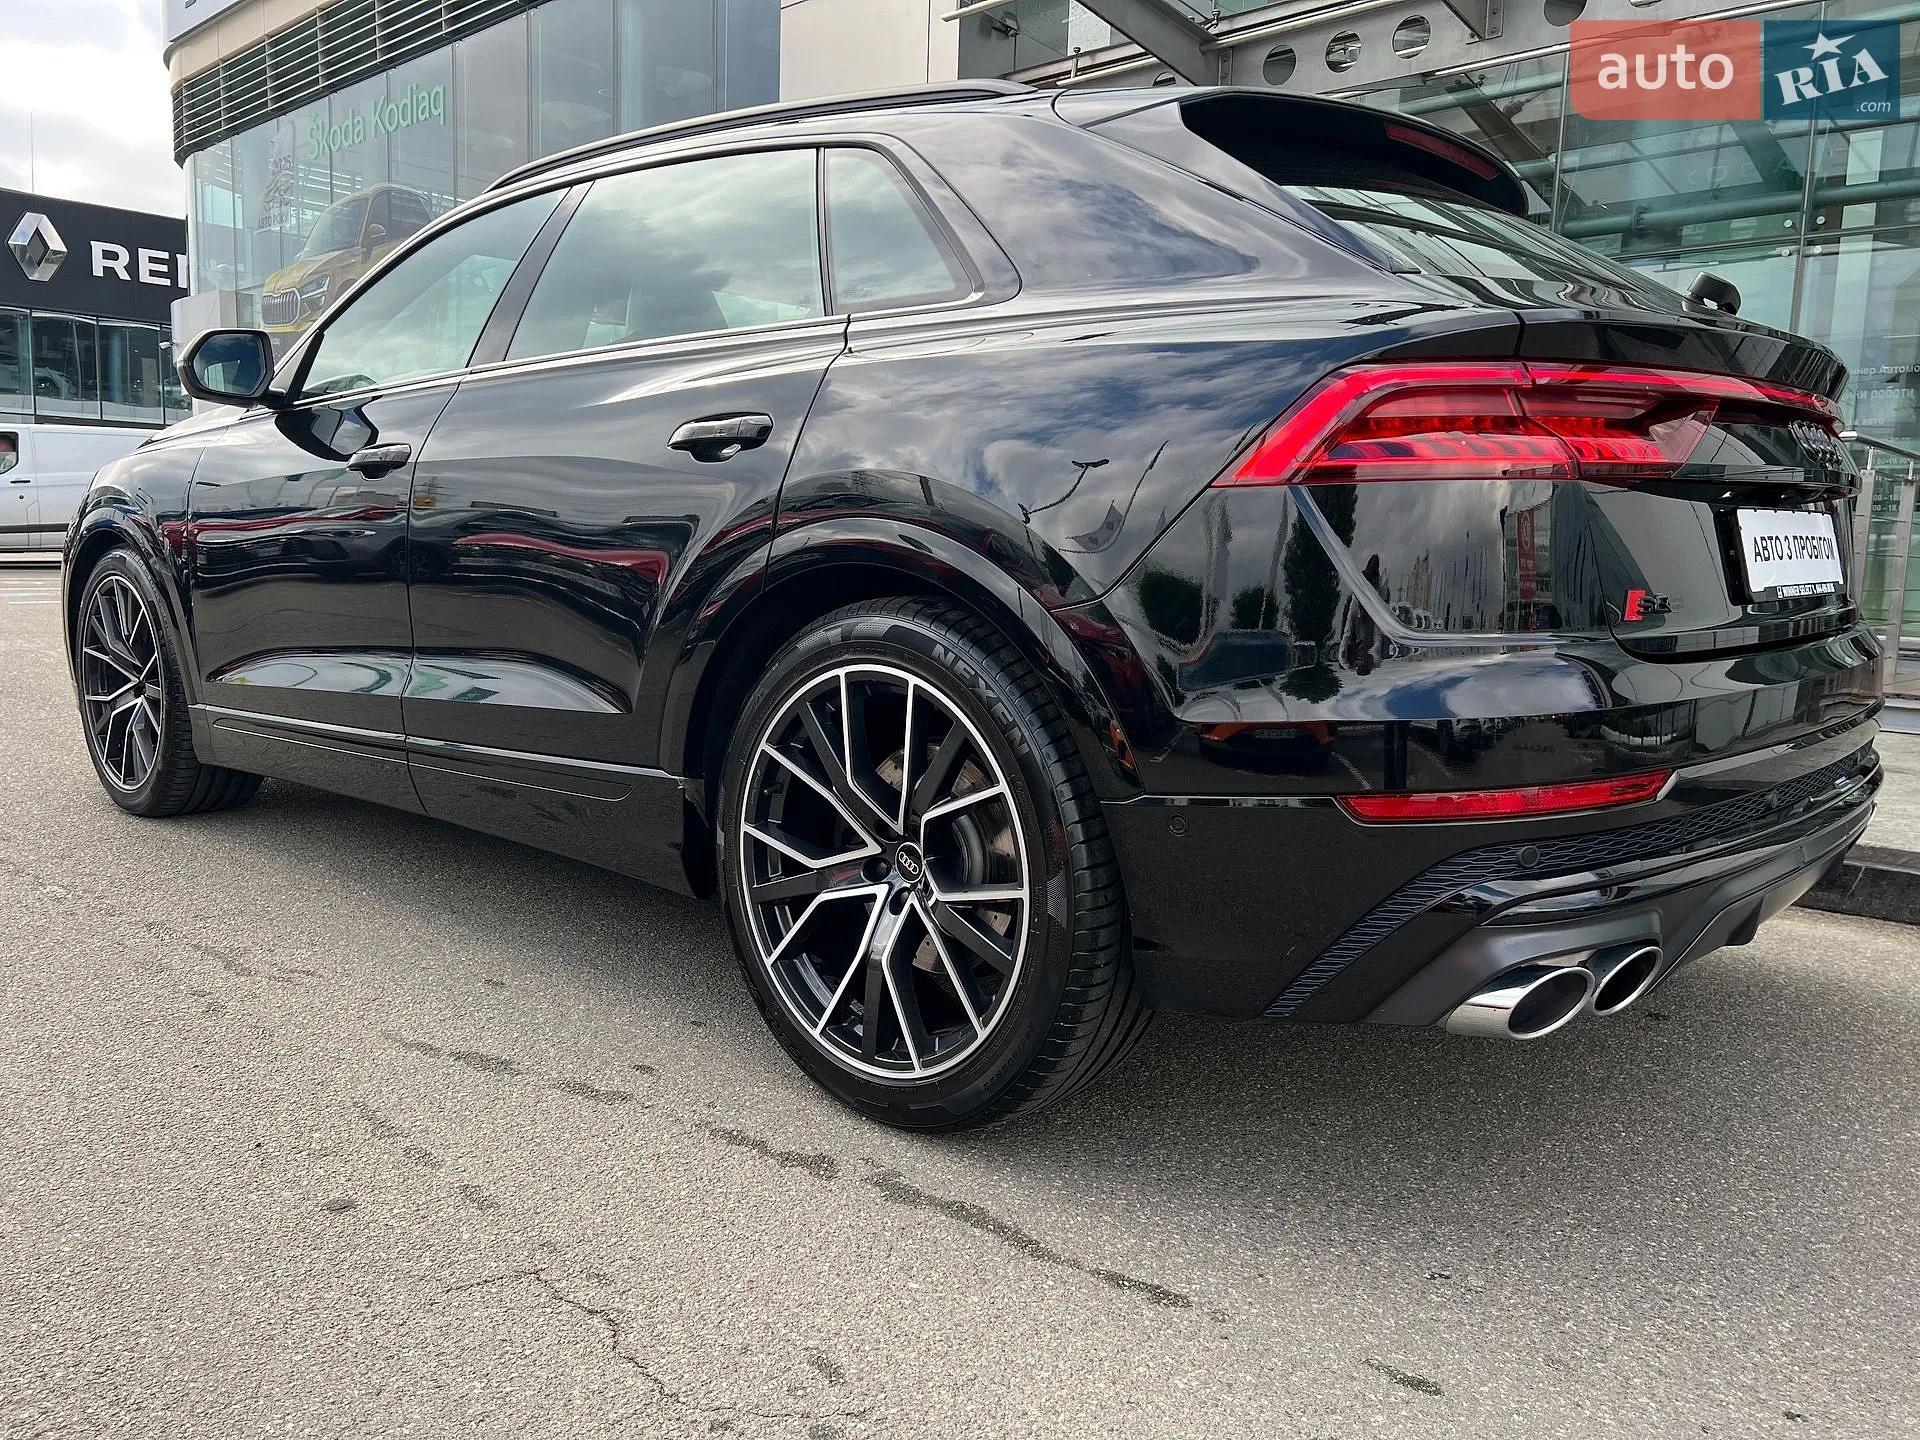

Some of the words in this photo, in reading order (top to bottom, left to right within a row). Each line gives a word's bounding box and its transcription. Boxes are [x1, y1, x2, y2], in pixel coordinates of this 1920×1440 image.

[306, 107, 366, 160] Škoda
[371, 83, 446, 137] Kodiaq
[1753, 535, 1784, 562] АВТО
[1792, 535, 1836, 560] ПРОБІГОМ
[931, 643, 1031, 757] NEXEN
